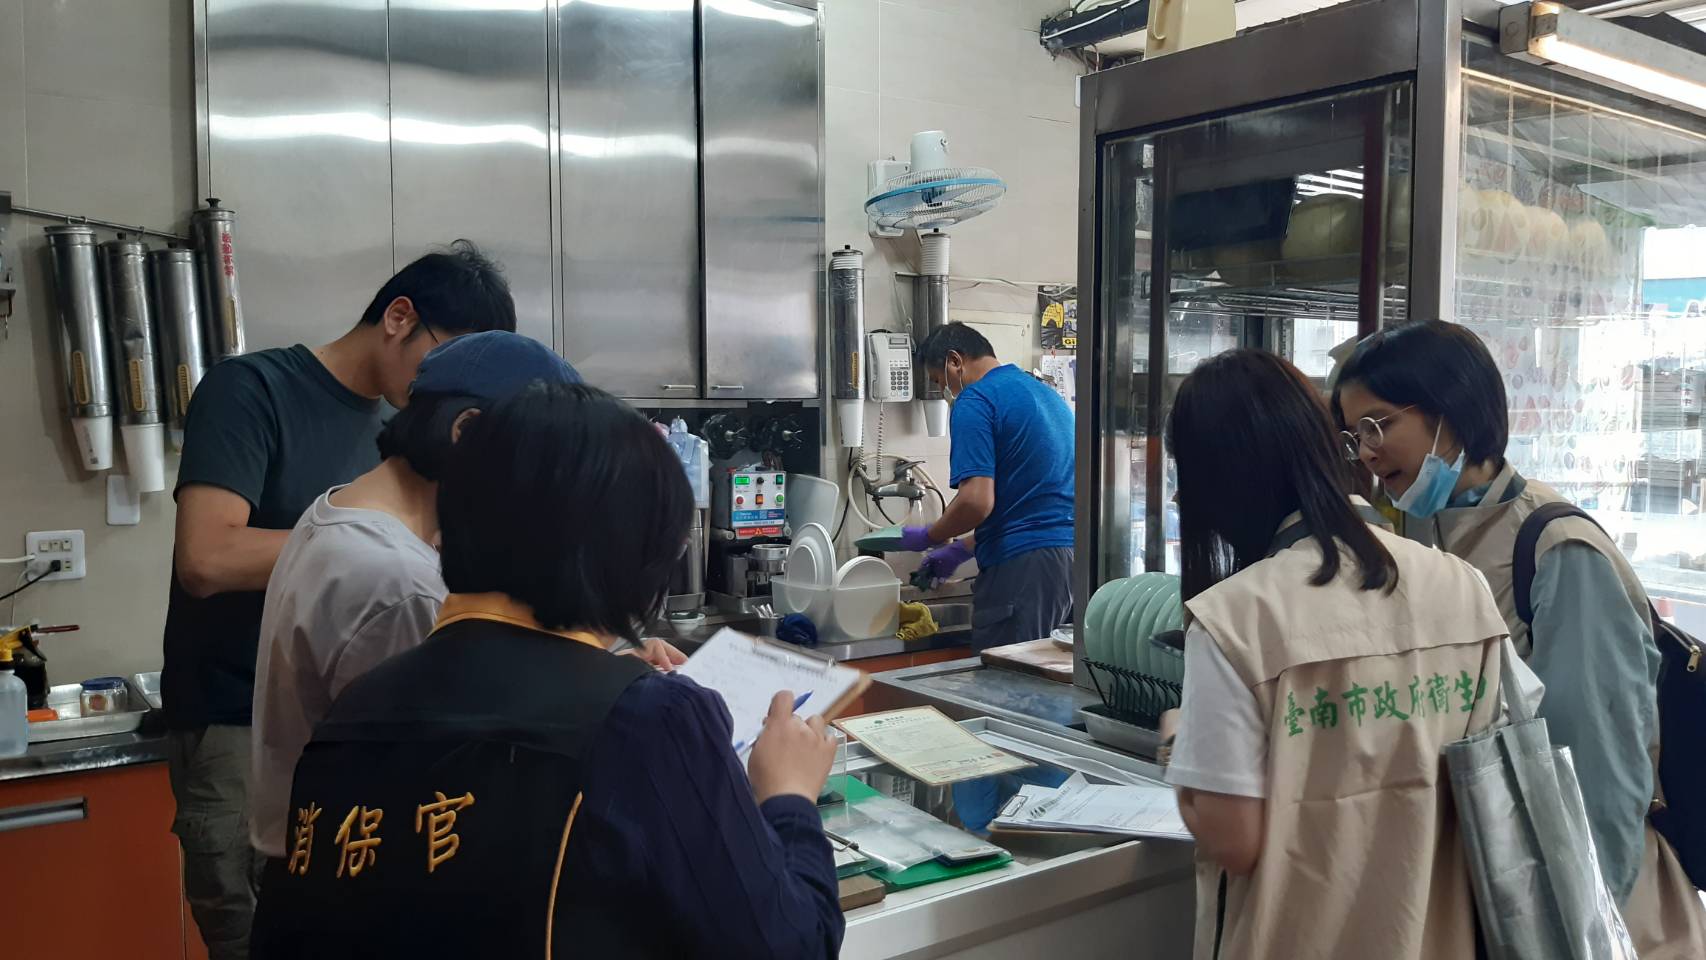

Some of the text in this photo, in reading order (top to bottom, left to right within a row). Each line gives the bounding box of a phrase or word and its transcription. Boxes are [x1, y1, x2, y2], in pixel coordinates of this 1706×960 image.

[1285, 670, 1487, 737] 臺南市政府衛生
